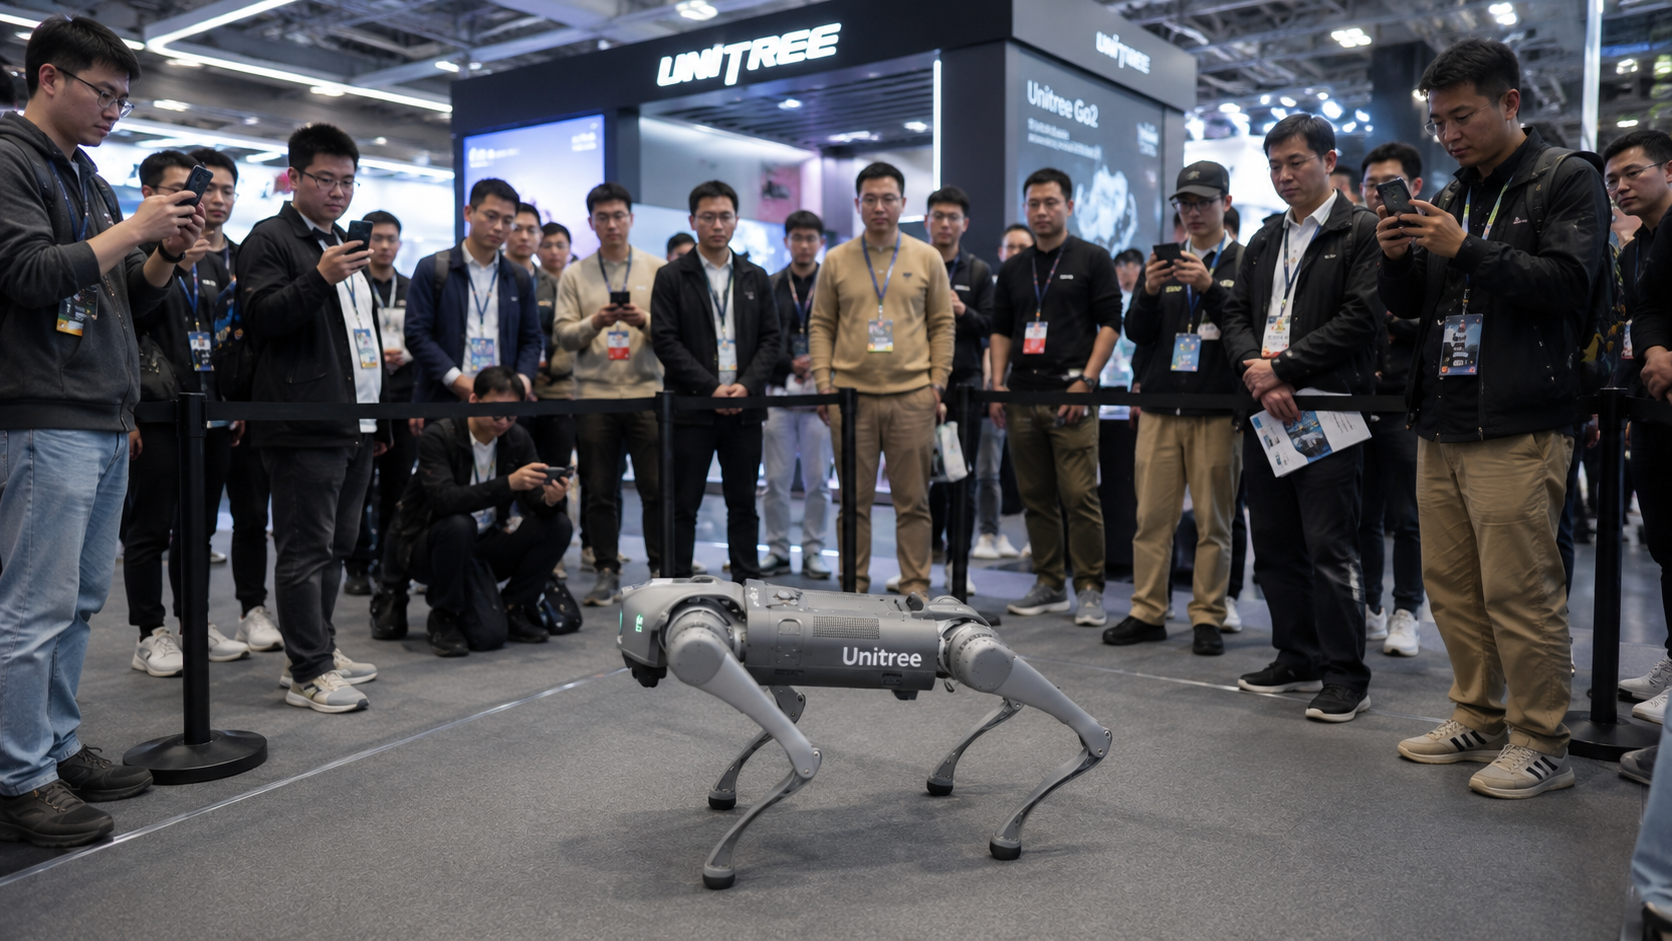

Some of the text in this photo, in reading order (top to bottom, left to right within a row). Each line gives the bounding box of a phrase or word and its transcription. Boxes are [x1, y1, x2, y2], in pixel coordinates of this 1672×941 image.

[657, 22, 842, 87] UNITREE
[1027, 80, 1099, 128] Unitree Go2
[842, 646, 922, 667] Unitree
